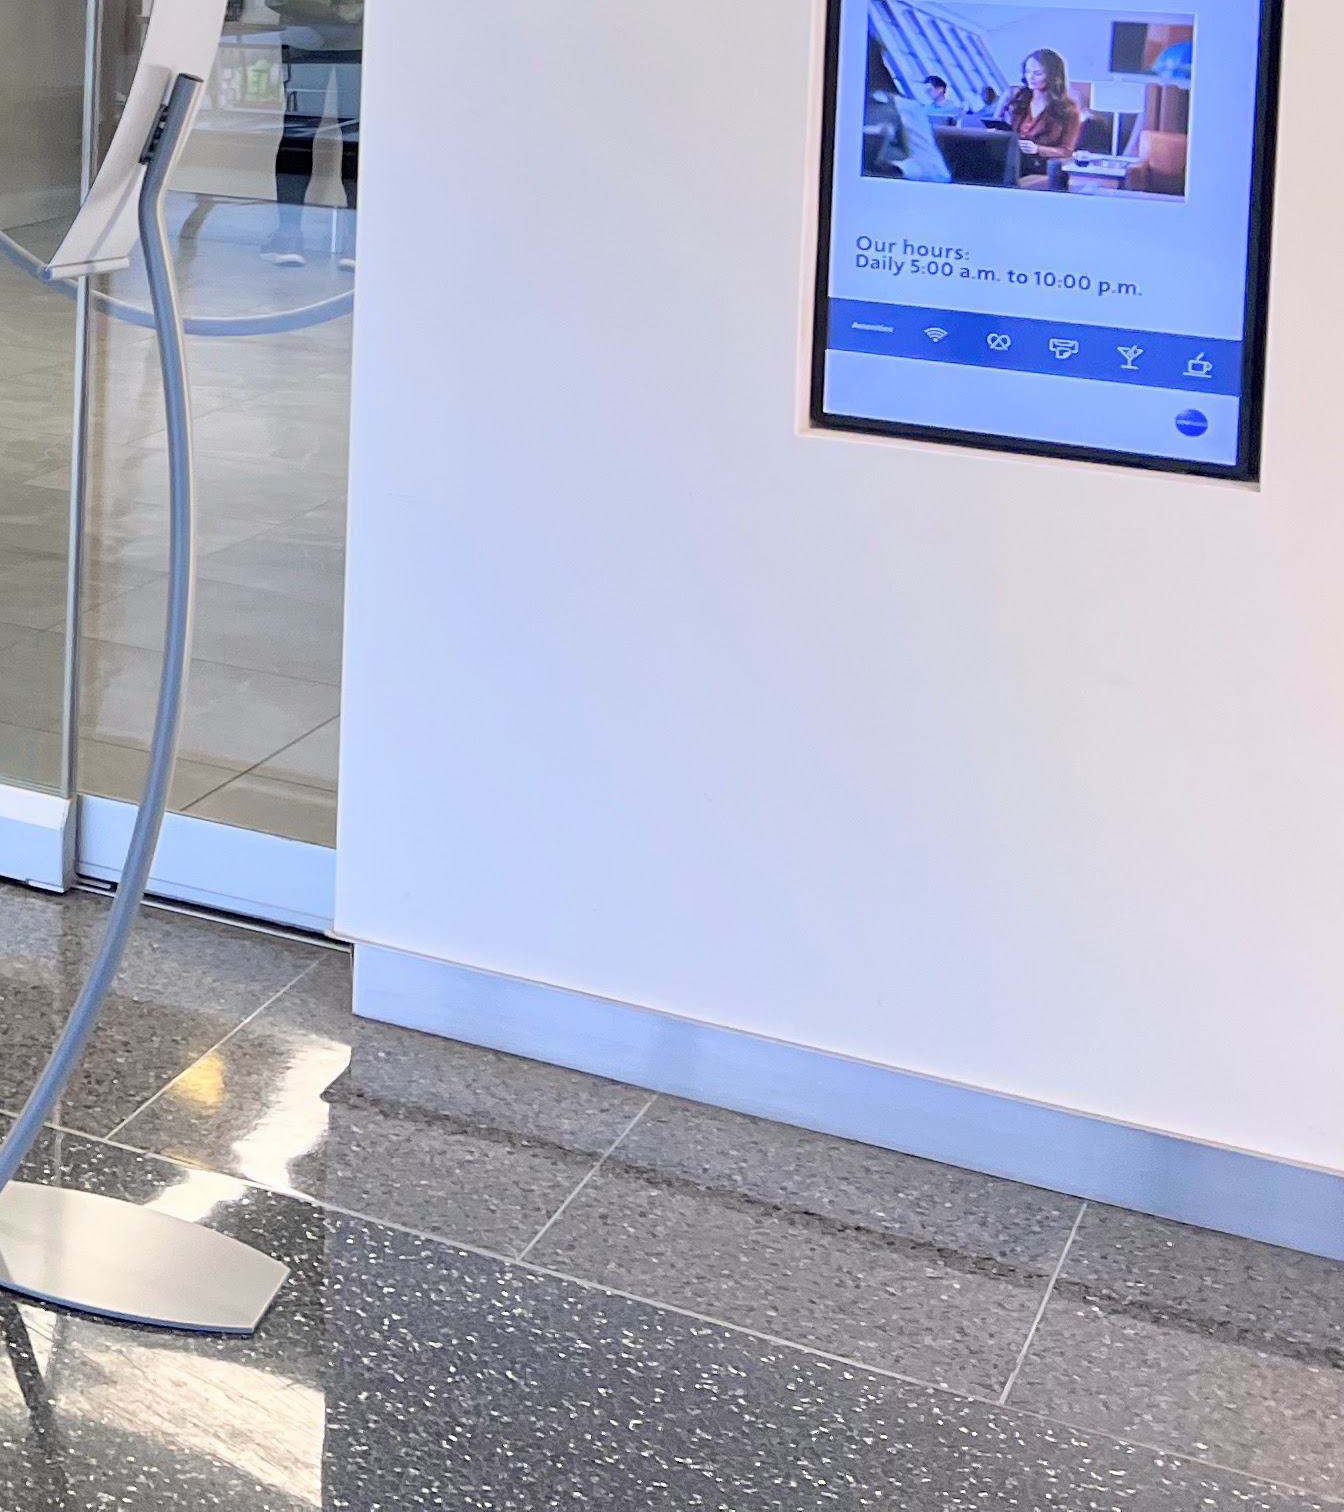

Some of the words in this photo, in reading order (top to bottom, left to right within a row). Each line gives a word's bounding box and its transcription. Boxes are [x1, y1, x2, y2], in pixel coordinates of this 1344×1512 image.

[855, 235, 897, 254] Our
[902, 238, 971, 261] hours:
[855, 254, 905, 276] Daily
[910, 259, 954, 277] 5:00
[959, 265, 1002, 282] a.m.
[1007, 268, 1029, 284] to
[1033, 270, 1092, 290] 10:00
[1097, 278, 1144, 297] p.m.
